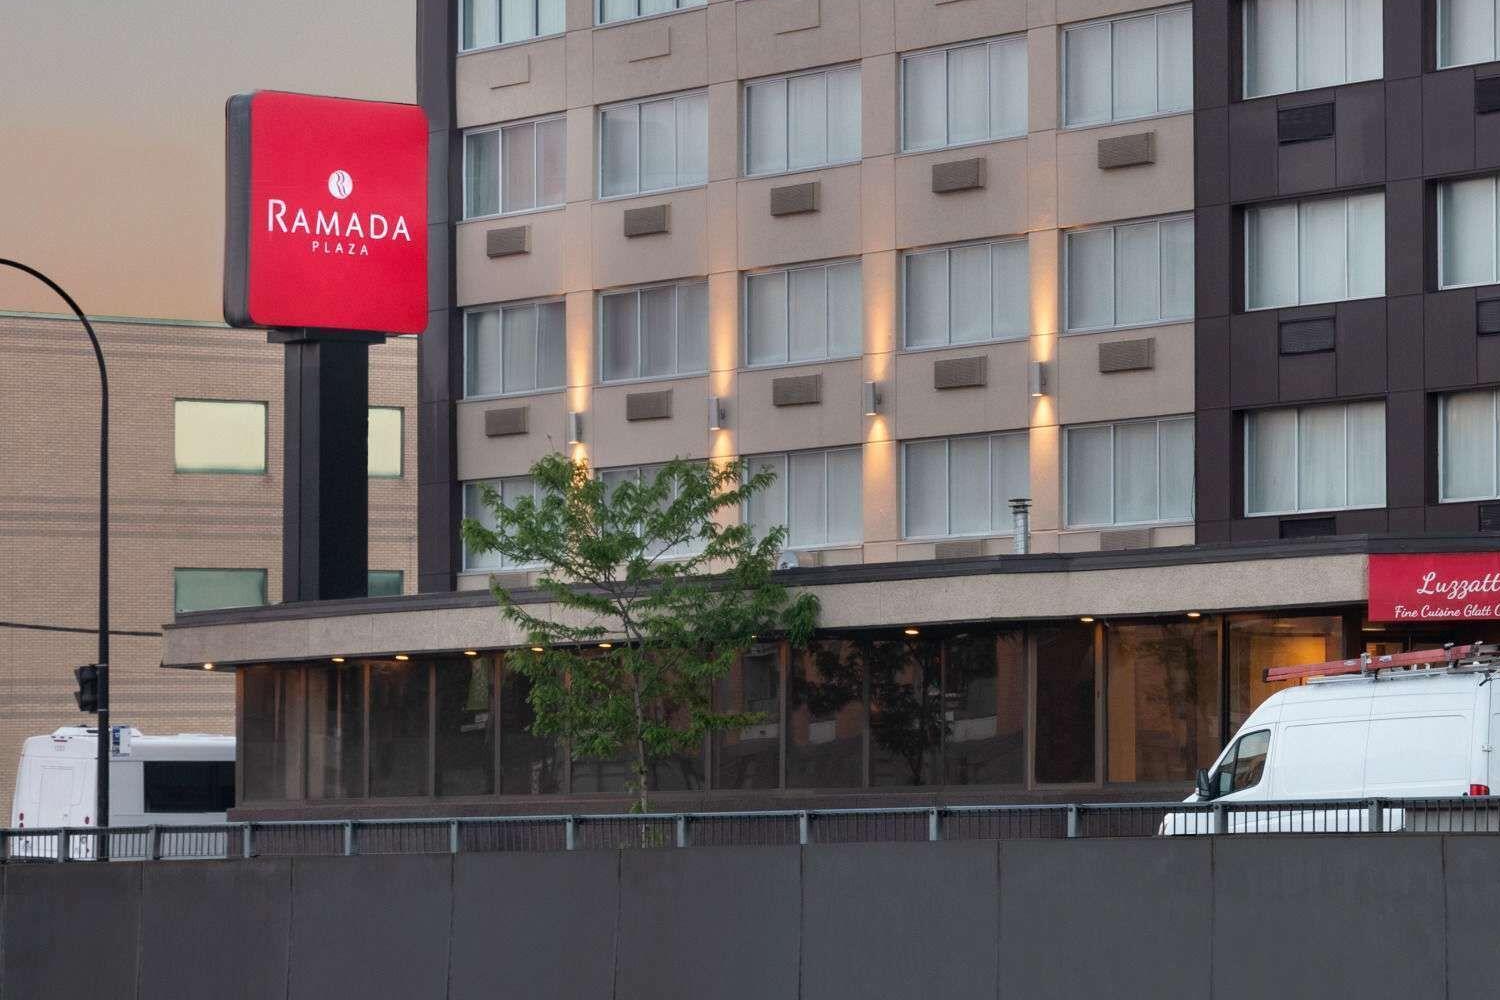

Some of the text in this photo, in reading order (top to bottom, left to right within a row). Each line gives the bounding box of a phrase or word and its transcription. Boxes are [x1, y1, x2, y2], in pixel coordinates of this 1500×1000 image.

[267, 198, 411, 242] RAMADA
[312, 241, 369, 256] PLAZA
[1394, 605, 1418, 618] Fine
[1420, 604, 1461, 618] Cuisine
[1463, 604, 1492, 617] Glatt
